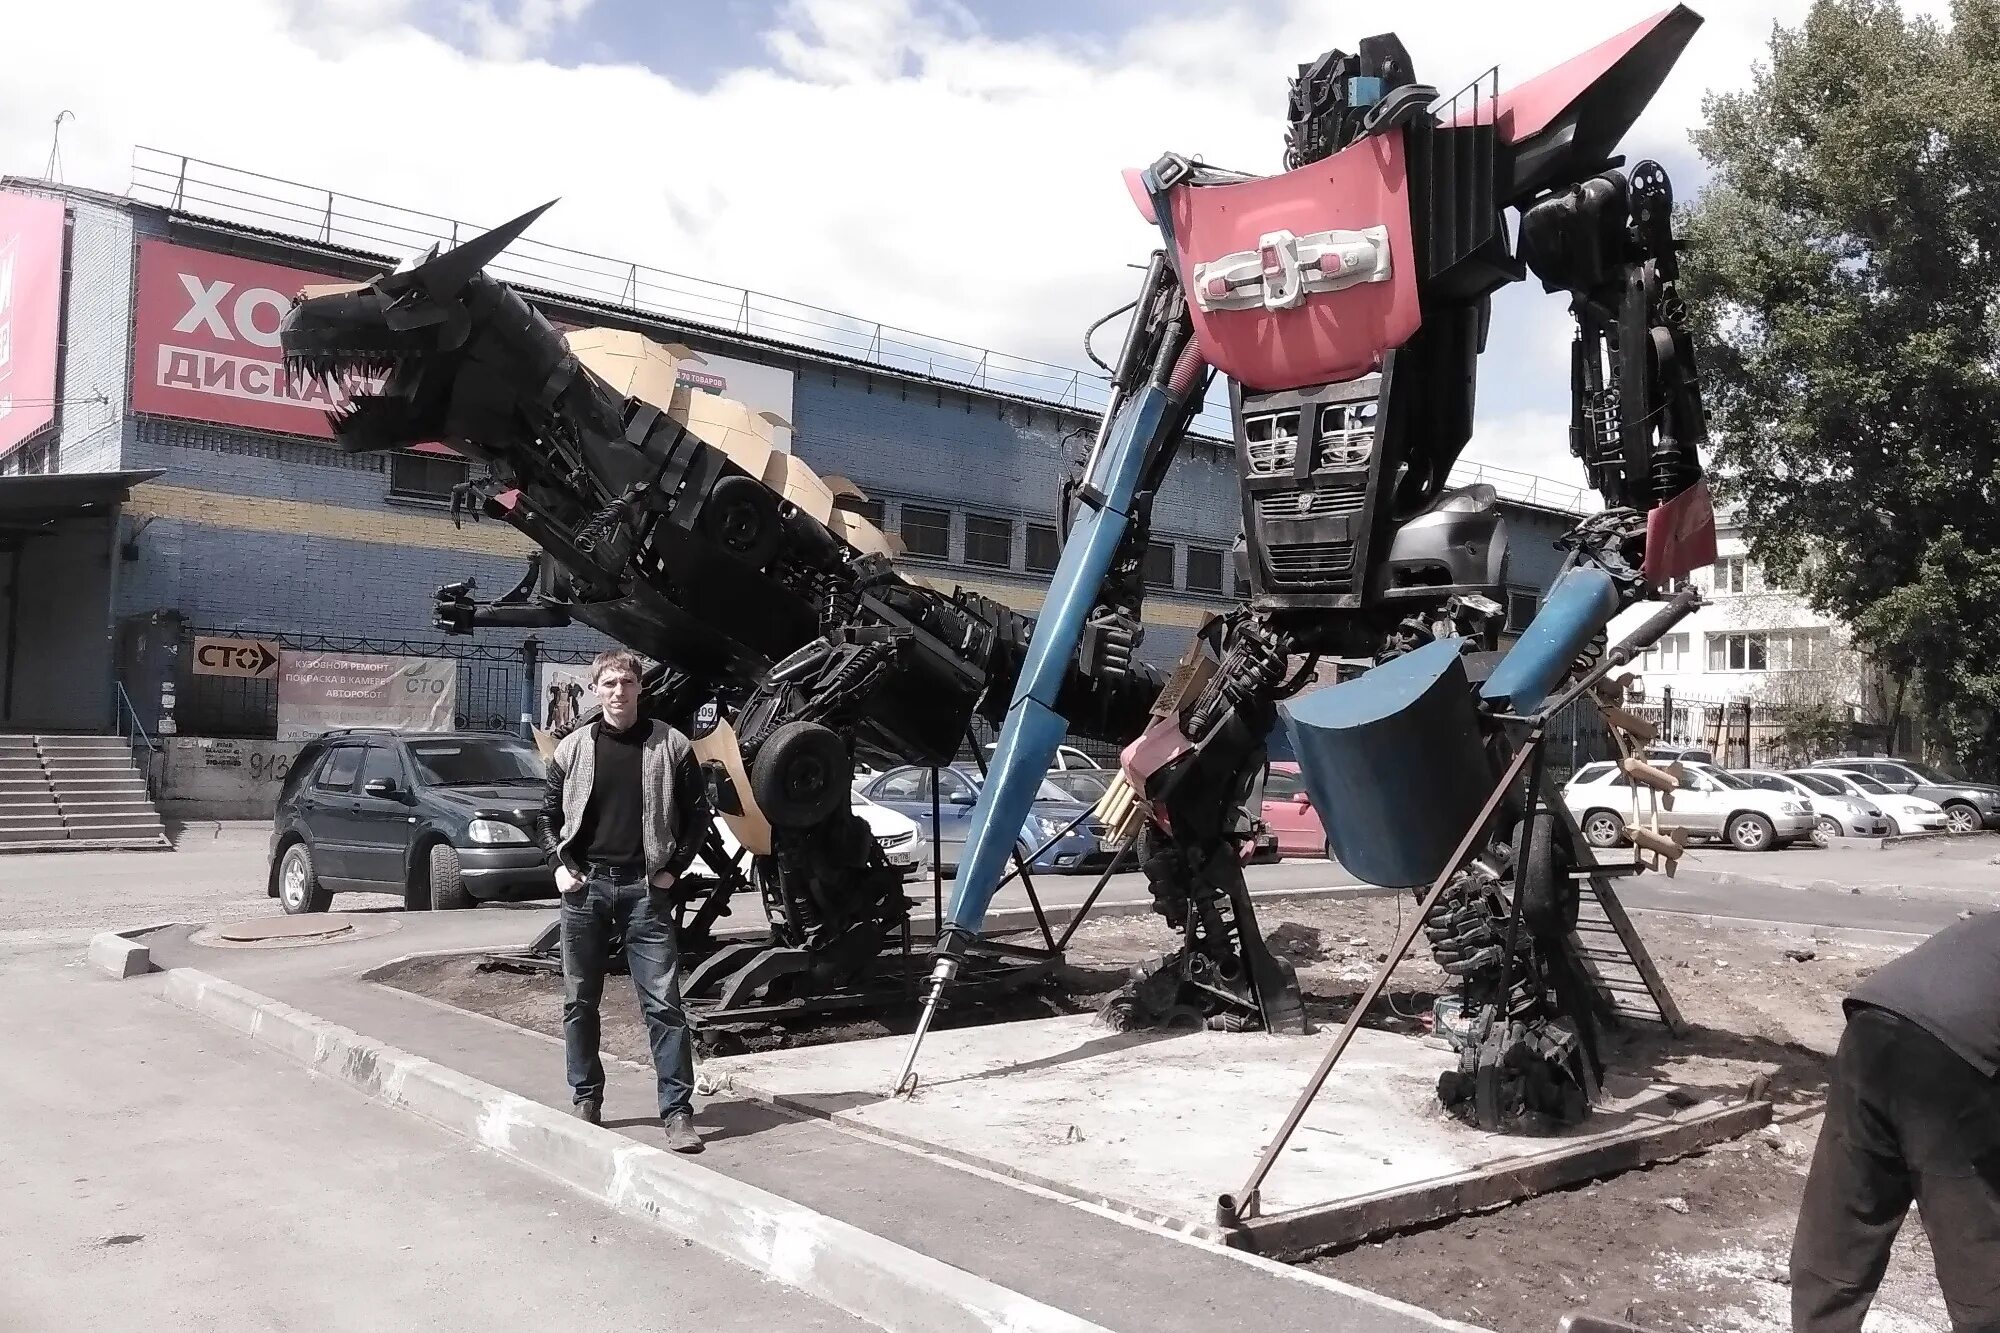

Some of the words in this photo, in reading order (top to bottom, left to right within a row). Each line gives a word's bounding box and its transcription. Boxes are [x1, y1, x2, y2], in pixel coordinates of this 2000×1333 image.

[172, 272, 292, 347] ХО
[691, 374, 722, 387] ТОВАРОВ
[198, 644, 259, 669] СТО
[295, 660, 348, 670] КУЗОВНОЙ
[350, 662, 389, 671] РЕМОНТ
[286, 673, 338, 683] ПОКРАСКА
[341, 676, 346, 684] В
[349, 676, 386, 685] КАМЕРЕ
[406, 679, 445, 694] СТО
[326, 689, 382, 699] АВТОРОБОТ
[698, 707, 714, 718] 09
